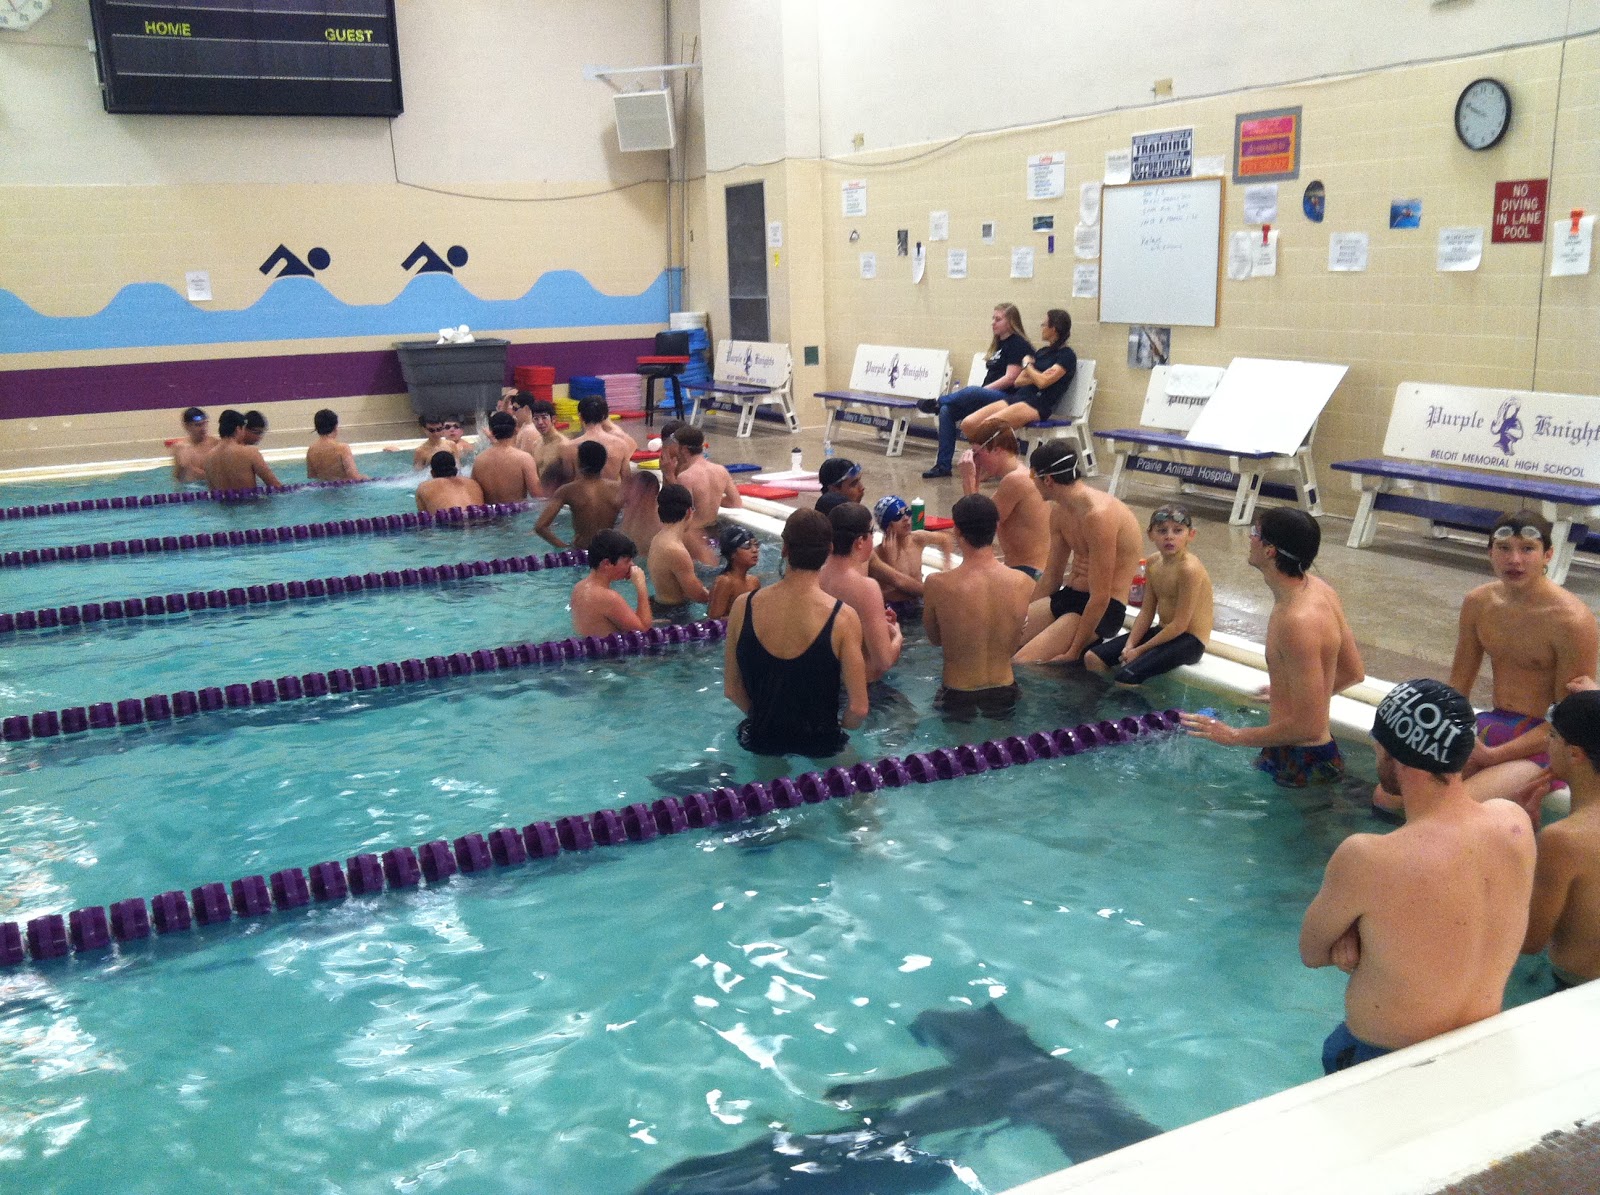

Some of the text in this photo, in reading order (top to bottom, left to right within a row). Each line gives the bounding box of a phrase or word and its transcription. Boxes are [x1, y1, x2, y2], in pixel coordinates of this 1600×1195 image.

[144, 20, 374, 43] HOME GUEST
[1512, 183, 1529, 198] NO
[1501, 196, 1539, 212] DIVING
[1496, 210, 1541, 225] IN LANE
[1502, 225, 1531, 239] POOL
[865, 360, 929, 381] Purple Knights
[1426, 404, 1600, 447] Purple Knight
[1136, 458, 1234, 483] Prairie Animal Hospital
[1430, 449, 1585, 478] BELOIT MEMORIAL HIGH SCHOOL
[1388, 683, 1462, 748] BELOIT
